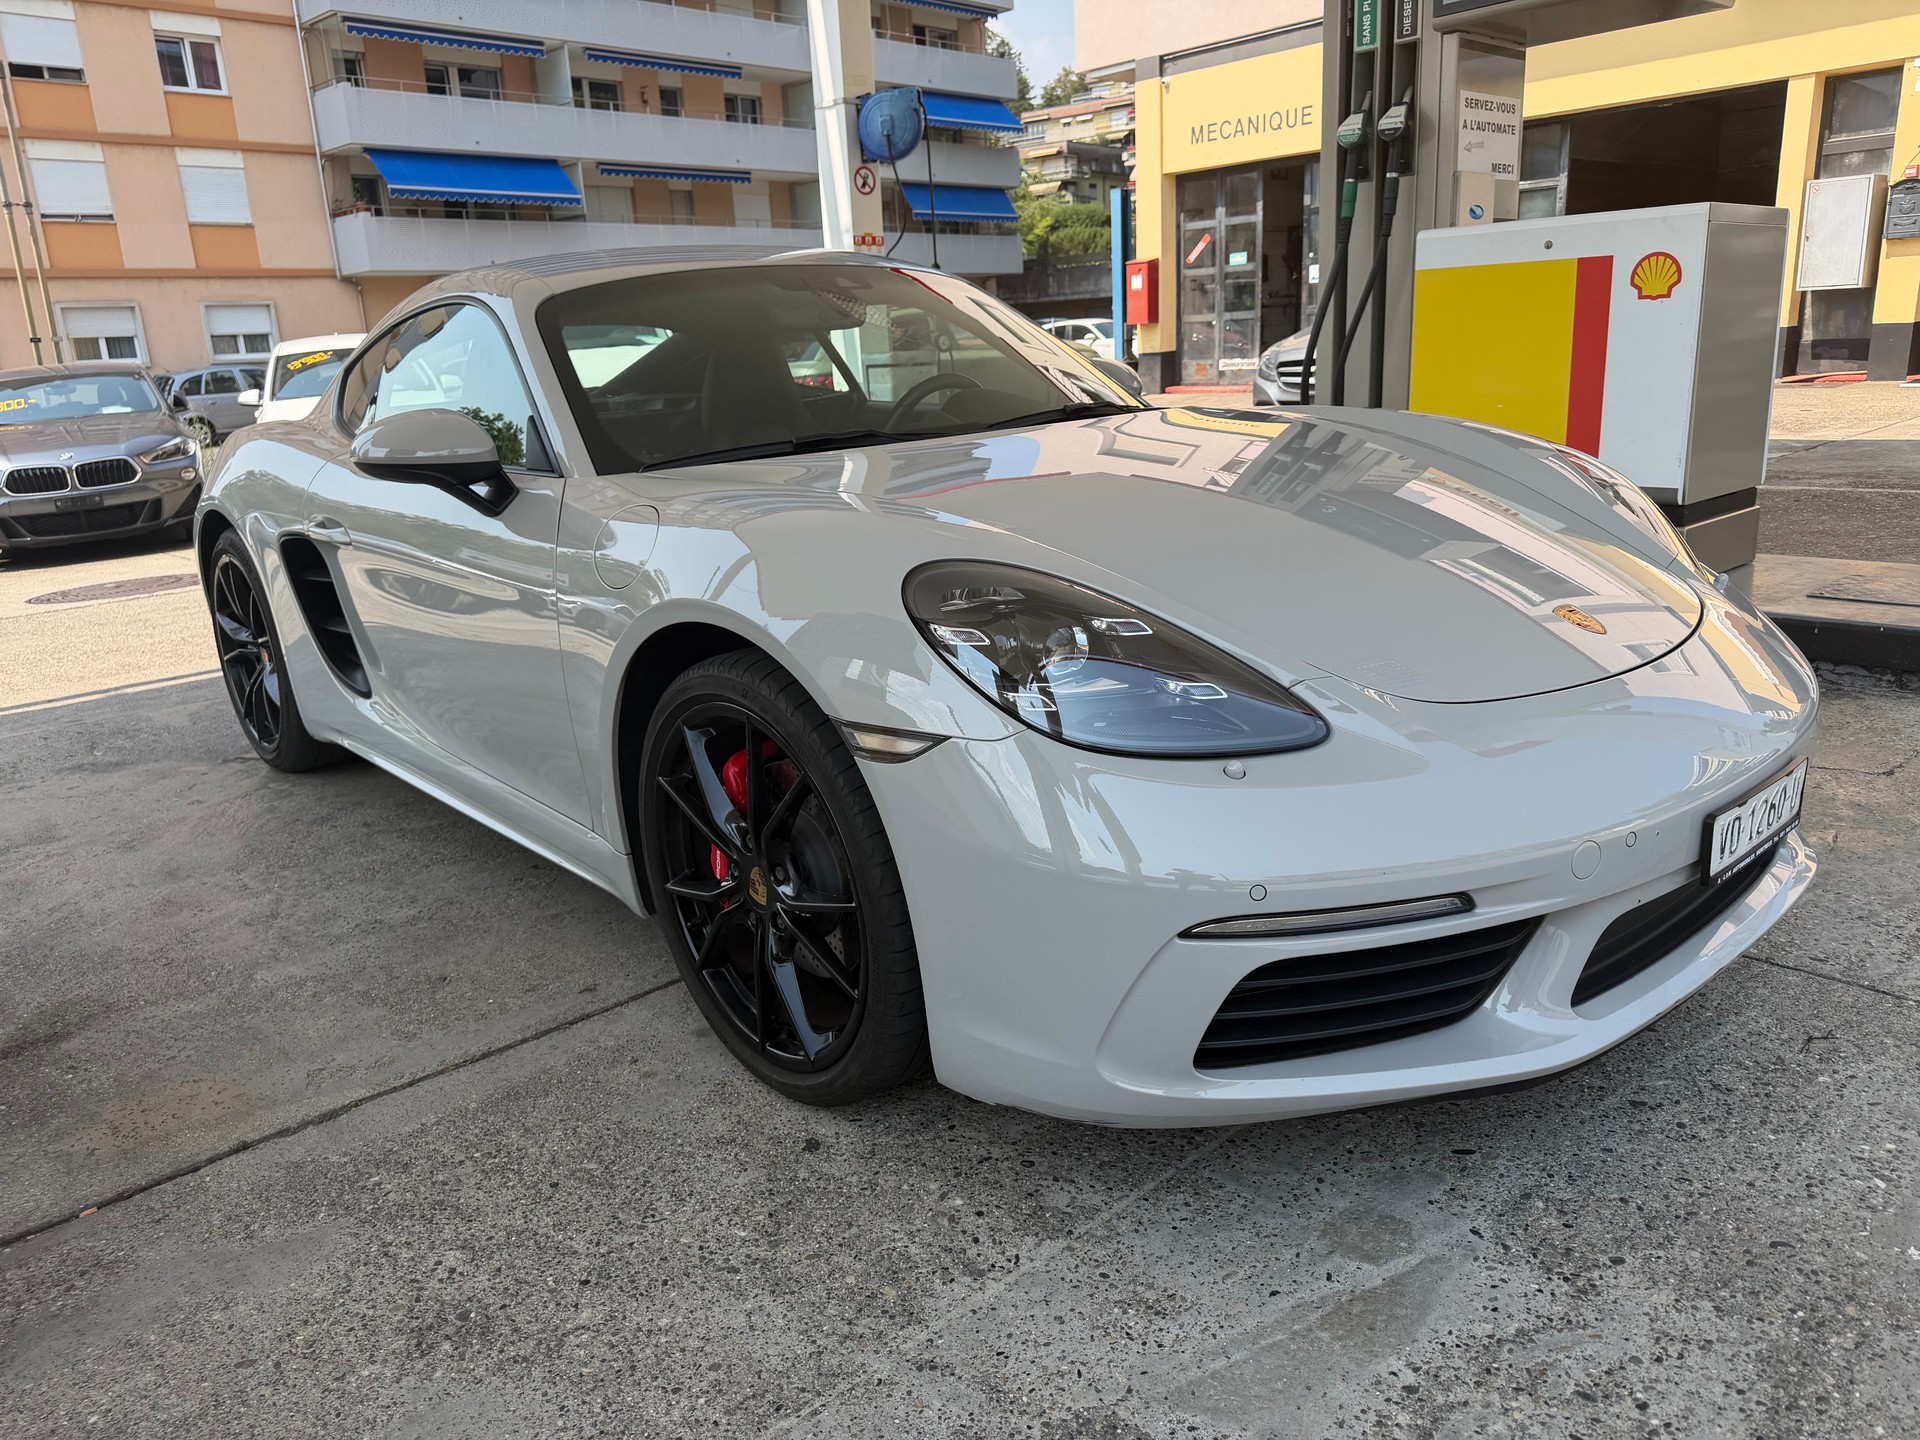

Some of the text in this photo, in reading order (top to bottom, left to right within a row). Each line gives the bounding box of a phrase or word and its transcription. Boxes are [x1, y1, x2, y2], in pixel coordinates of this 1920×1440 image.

[1362, 14, 1371, 44] SANS
[1403, 0, 1412, 35] DIESE
[1464, 97, 1516, 115] SERVEZ-VOUS
[1190, 105, 1313, 145] MECANIQUE
[1462, 119, 1516, 136] A L'AUTOMATE
[1491, 162, 1515, 175] MERCI
